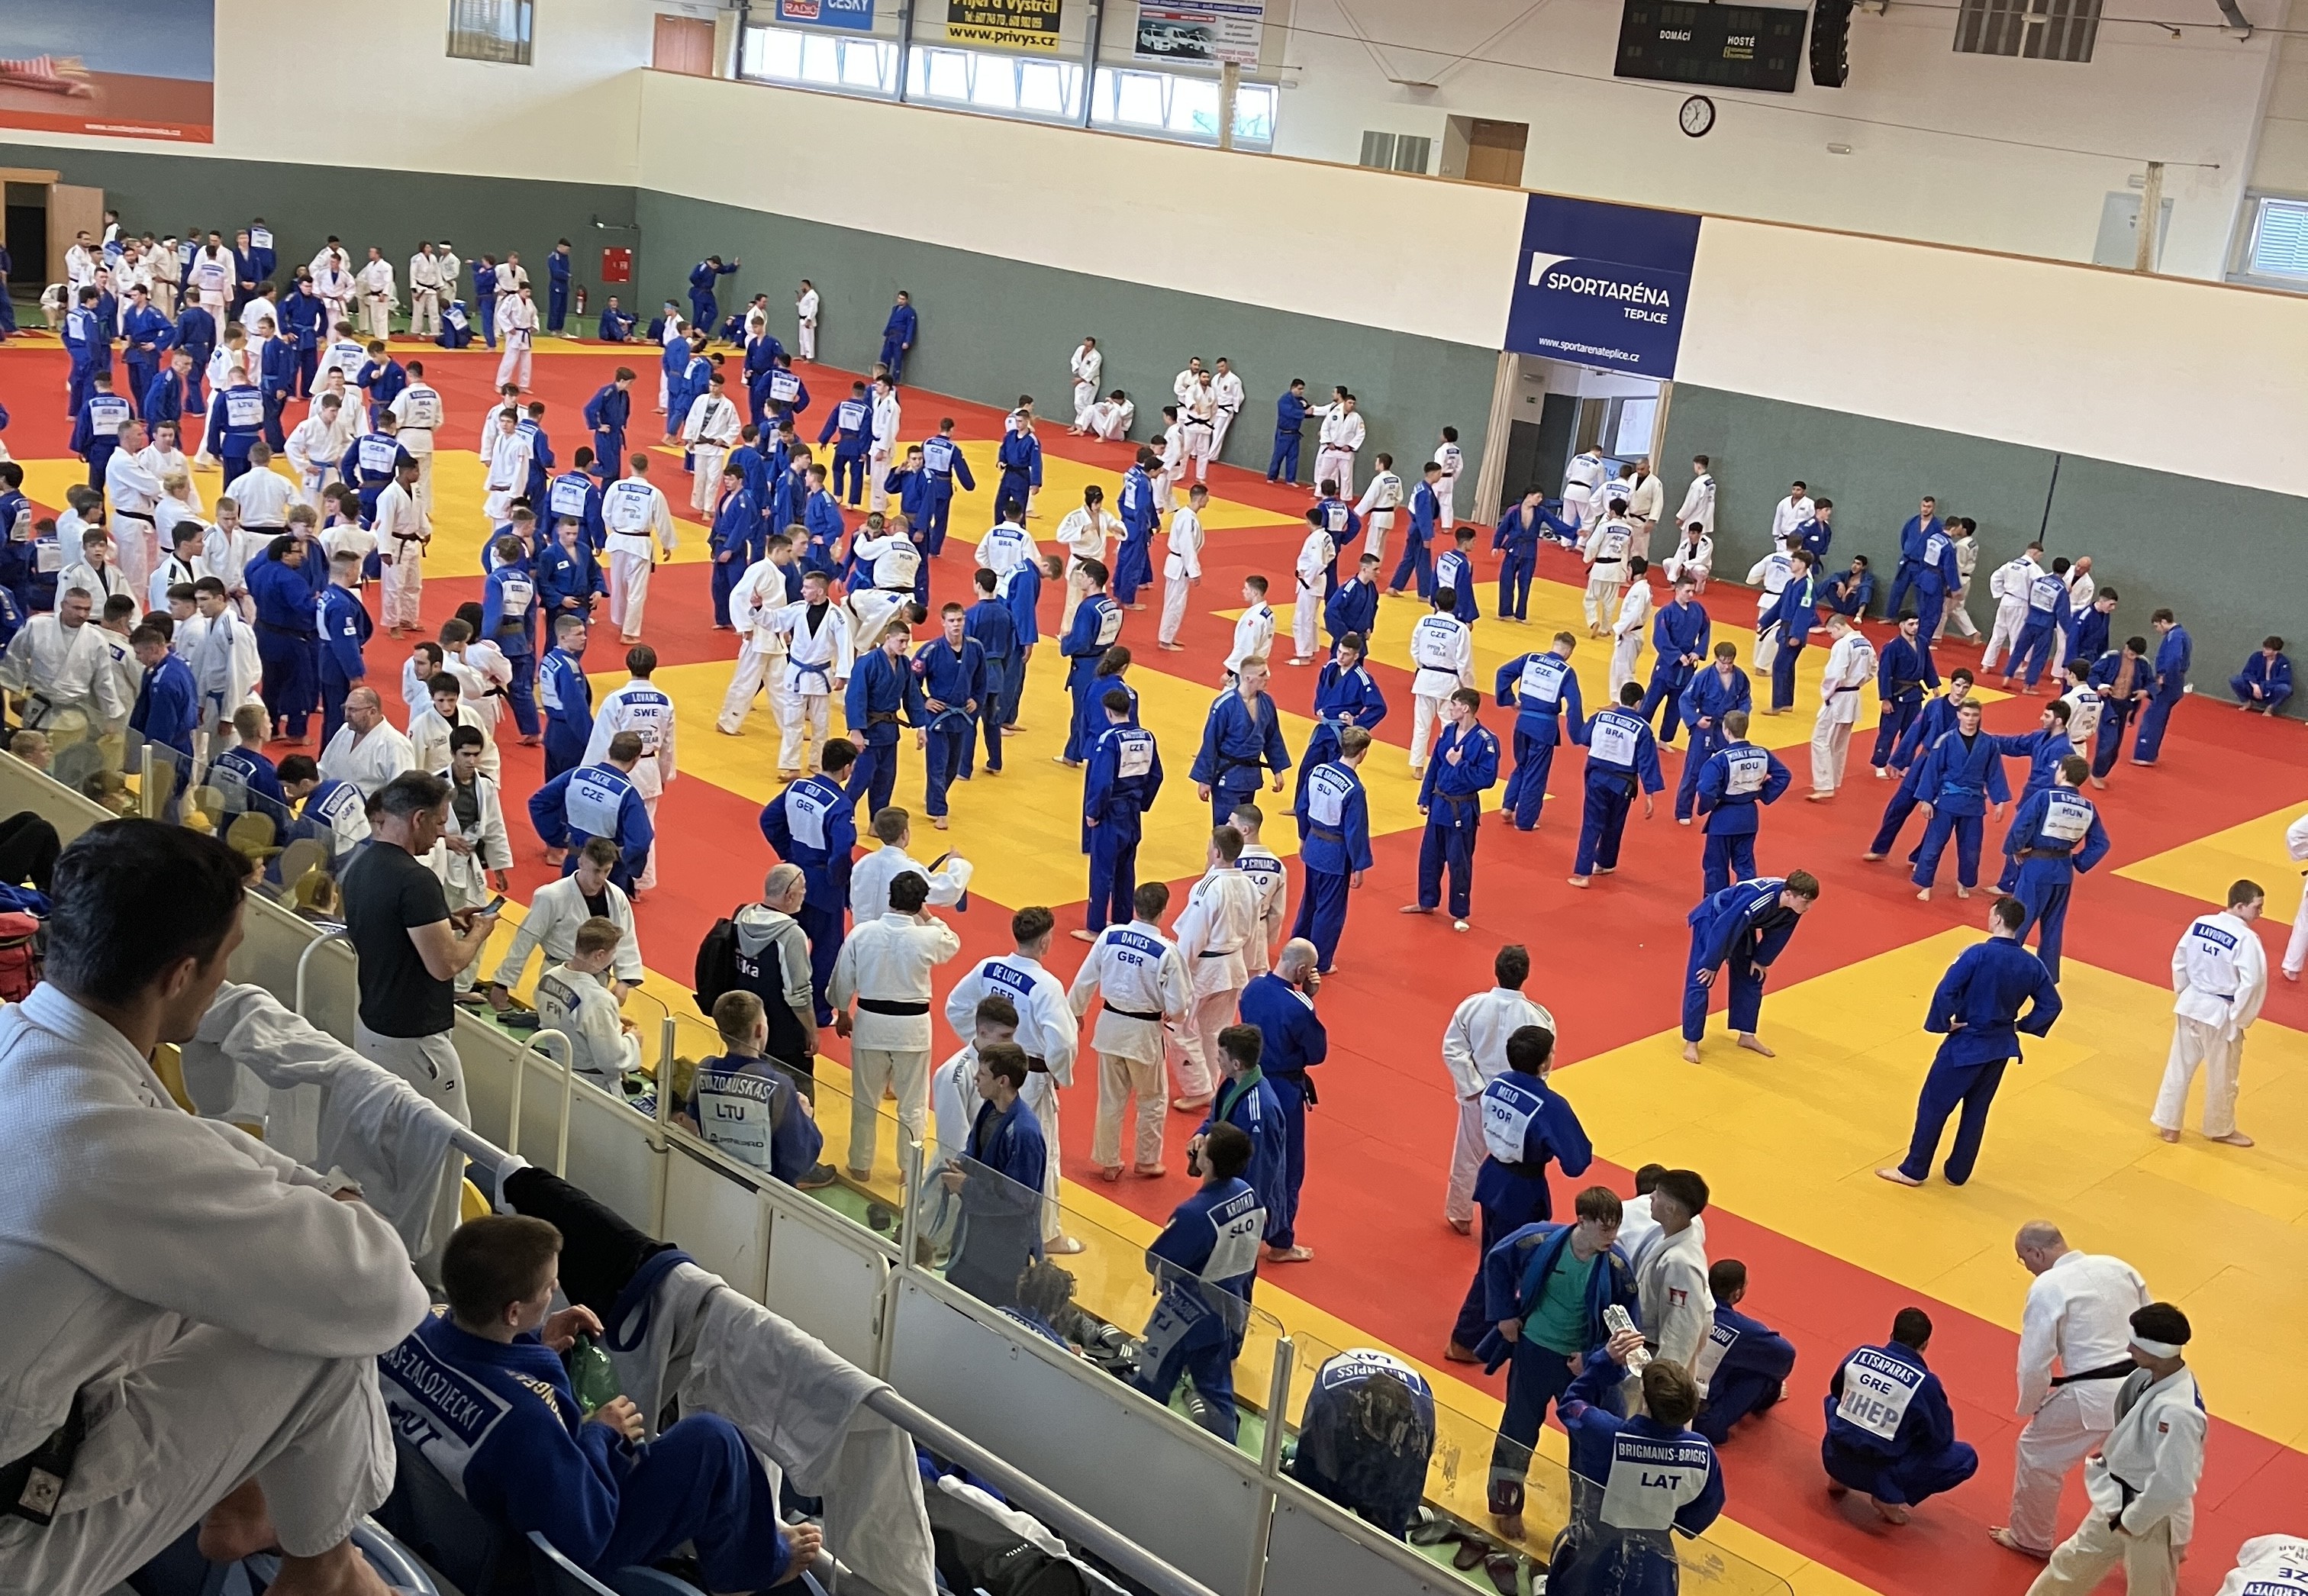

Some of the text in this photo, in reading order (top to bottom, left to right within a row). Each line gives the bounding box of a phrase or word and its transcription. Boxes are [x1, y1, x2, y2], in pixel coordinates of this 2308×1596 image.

[949, 27, 1055, 47] www.privys.cz
[1659, 29, 1755, 47] DOMÁCÍ HOSTÉ
[1546, 272, 1670, 308] SPORTARÉNA
[1624, 308, 1668, 324] TEPLICE
[1539, 337, 1640, 363] www.sportarenateplice.cz
[1430, 630, 1447, 640] CZE
[1534, 667, 1552, 678] CZE
[633, 708, 659, 718] SWE
[1605, 727, 1624, 740] BRA
[1129, 743, 1144, 752] CZE
[1740, 762, 1759, 772] ROU
[582, 787, 605, 803] CZE
[796, 798, 814, 815] GER
[2062, 807, 2084, 817] HUN
[1251, 875, 1268, 885] LO
[1121, 932, 1149, 951] DAVIES
[2203, 943, 2220, 956] LAT
[1117, 950, 1143, 967] GBR
[992, 964, 1023, 987] DE LUCA
[1497, 1085, 1517, 1104] MELO
[716, 1103, 746, 1120] LTU
[1225, 1192, 1253, 1218] KROTKO
[1230, 1218, 1252, 1239] SLO
[1710, 1325, 1733, 1343] SIOU
[1356, 1353, 1391, 1364] LAT
[382, 1343, 484, 1431] AS-ZALOZIECKI
[1859, 1373, 1893, 1396] GRE
[1617, 1442, 1708, 1465] BRIGMANIS-BRIGIS
[1641, 1472, 1683, 1491] LAT
[2277, 1567, 2308, 1584] ZE
[2245, 1584, 2302, 1596] ERDIYEV
